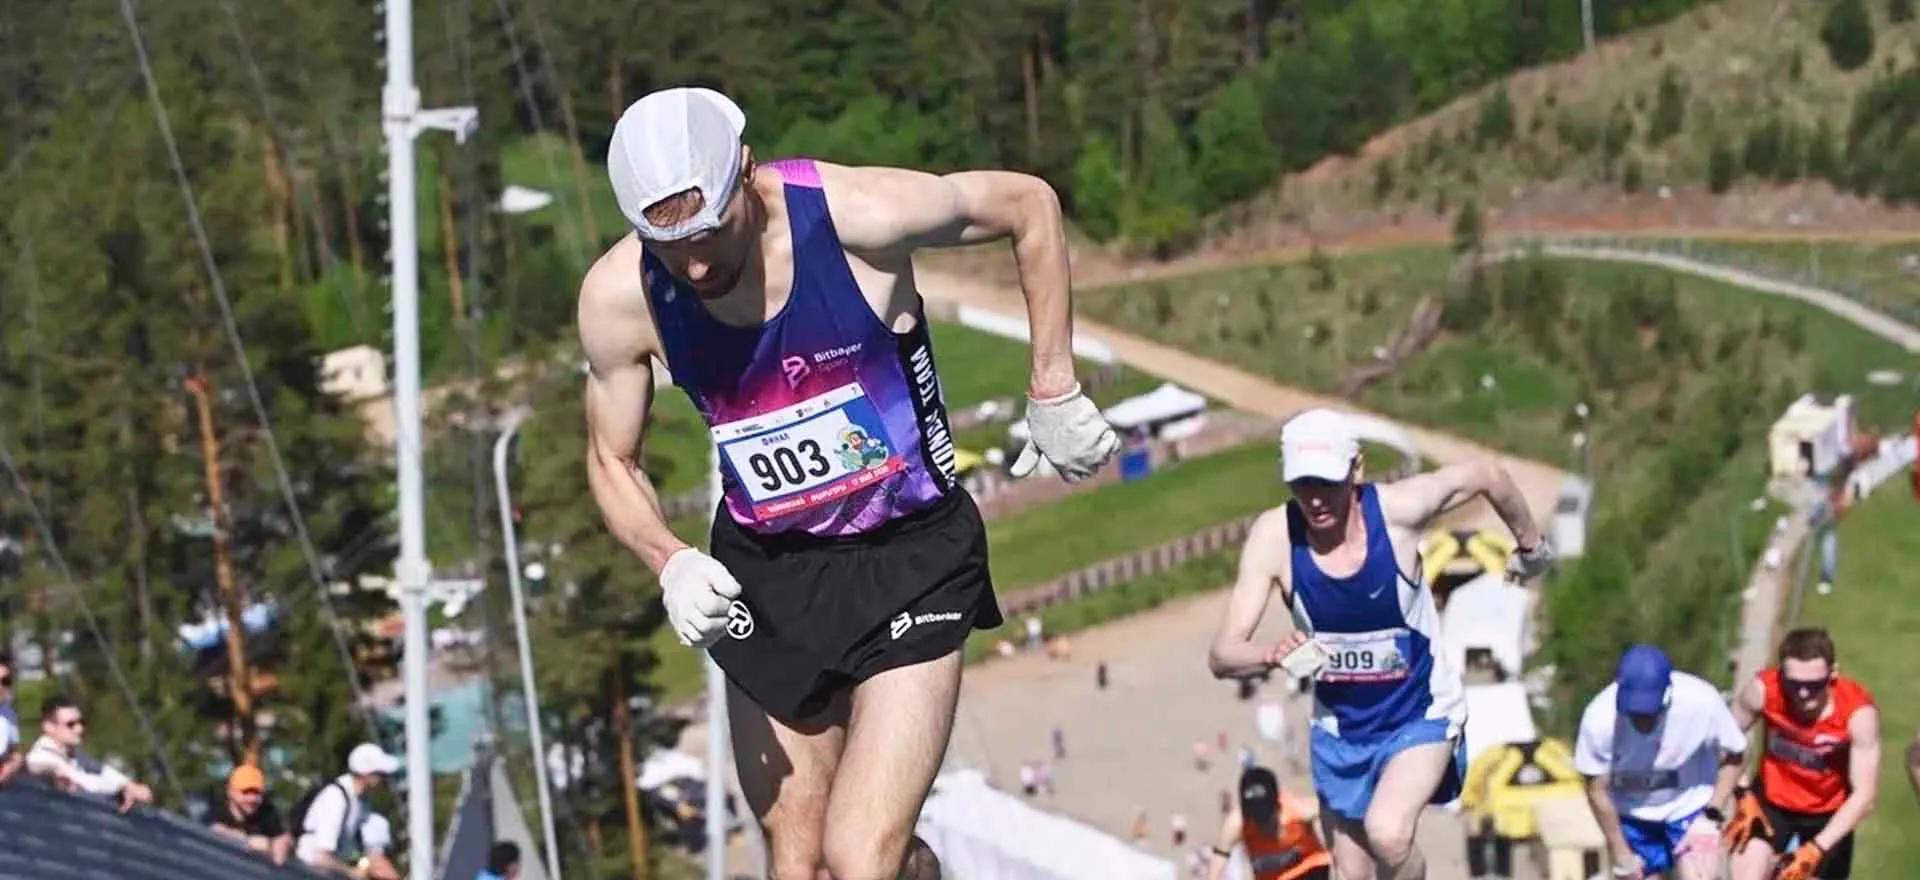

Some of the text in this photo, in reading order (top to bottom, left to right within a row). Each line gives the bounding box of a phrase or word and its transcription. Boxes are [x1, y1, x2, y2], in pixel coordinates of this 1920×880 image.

[910, 344, 937, 407] TEAM
[750, 439, 831, 491] 903
[1329, 650, 1374, 669] 909
